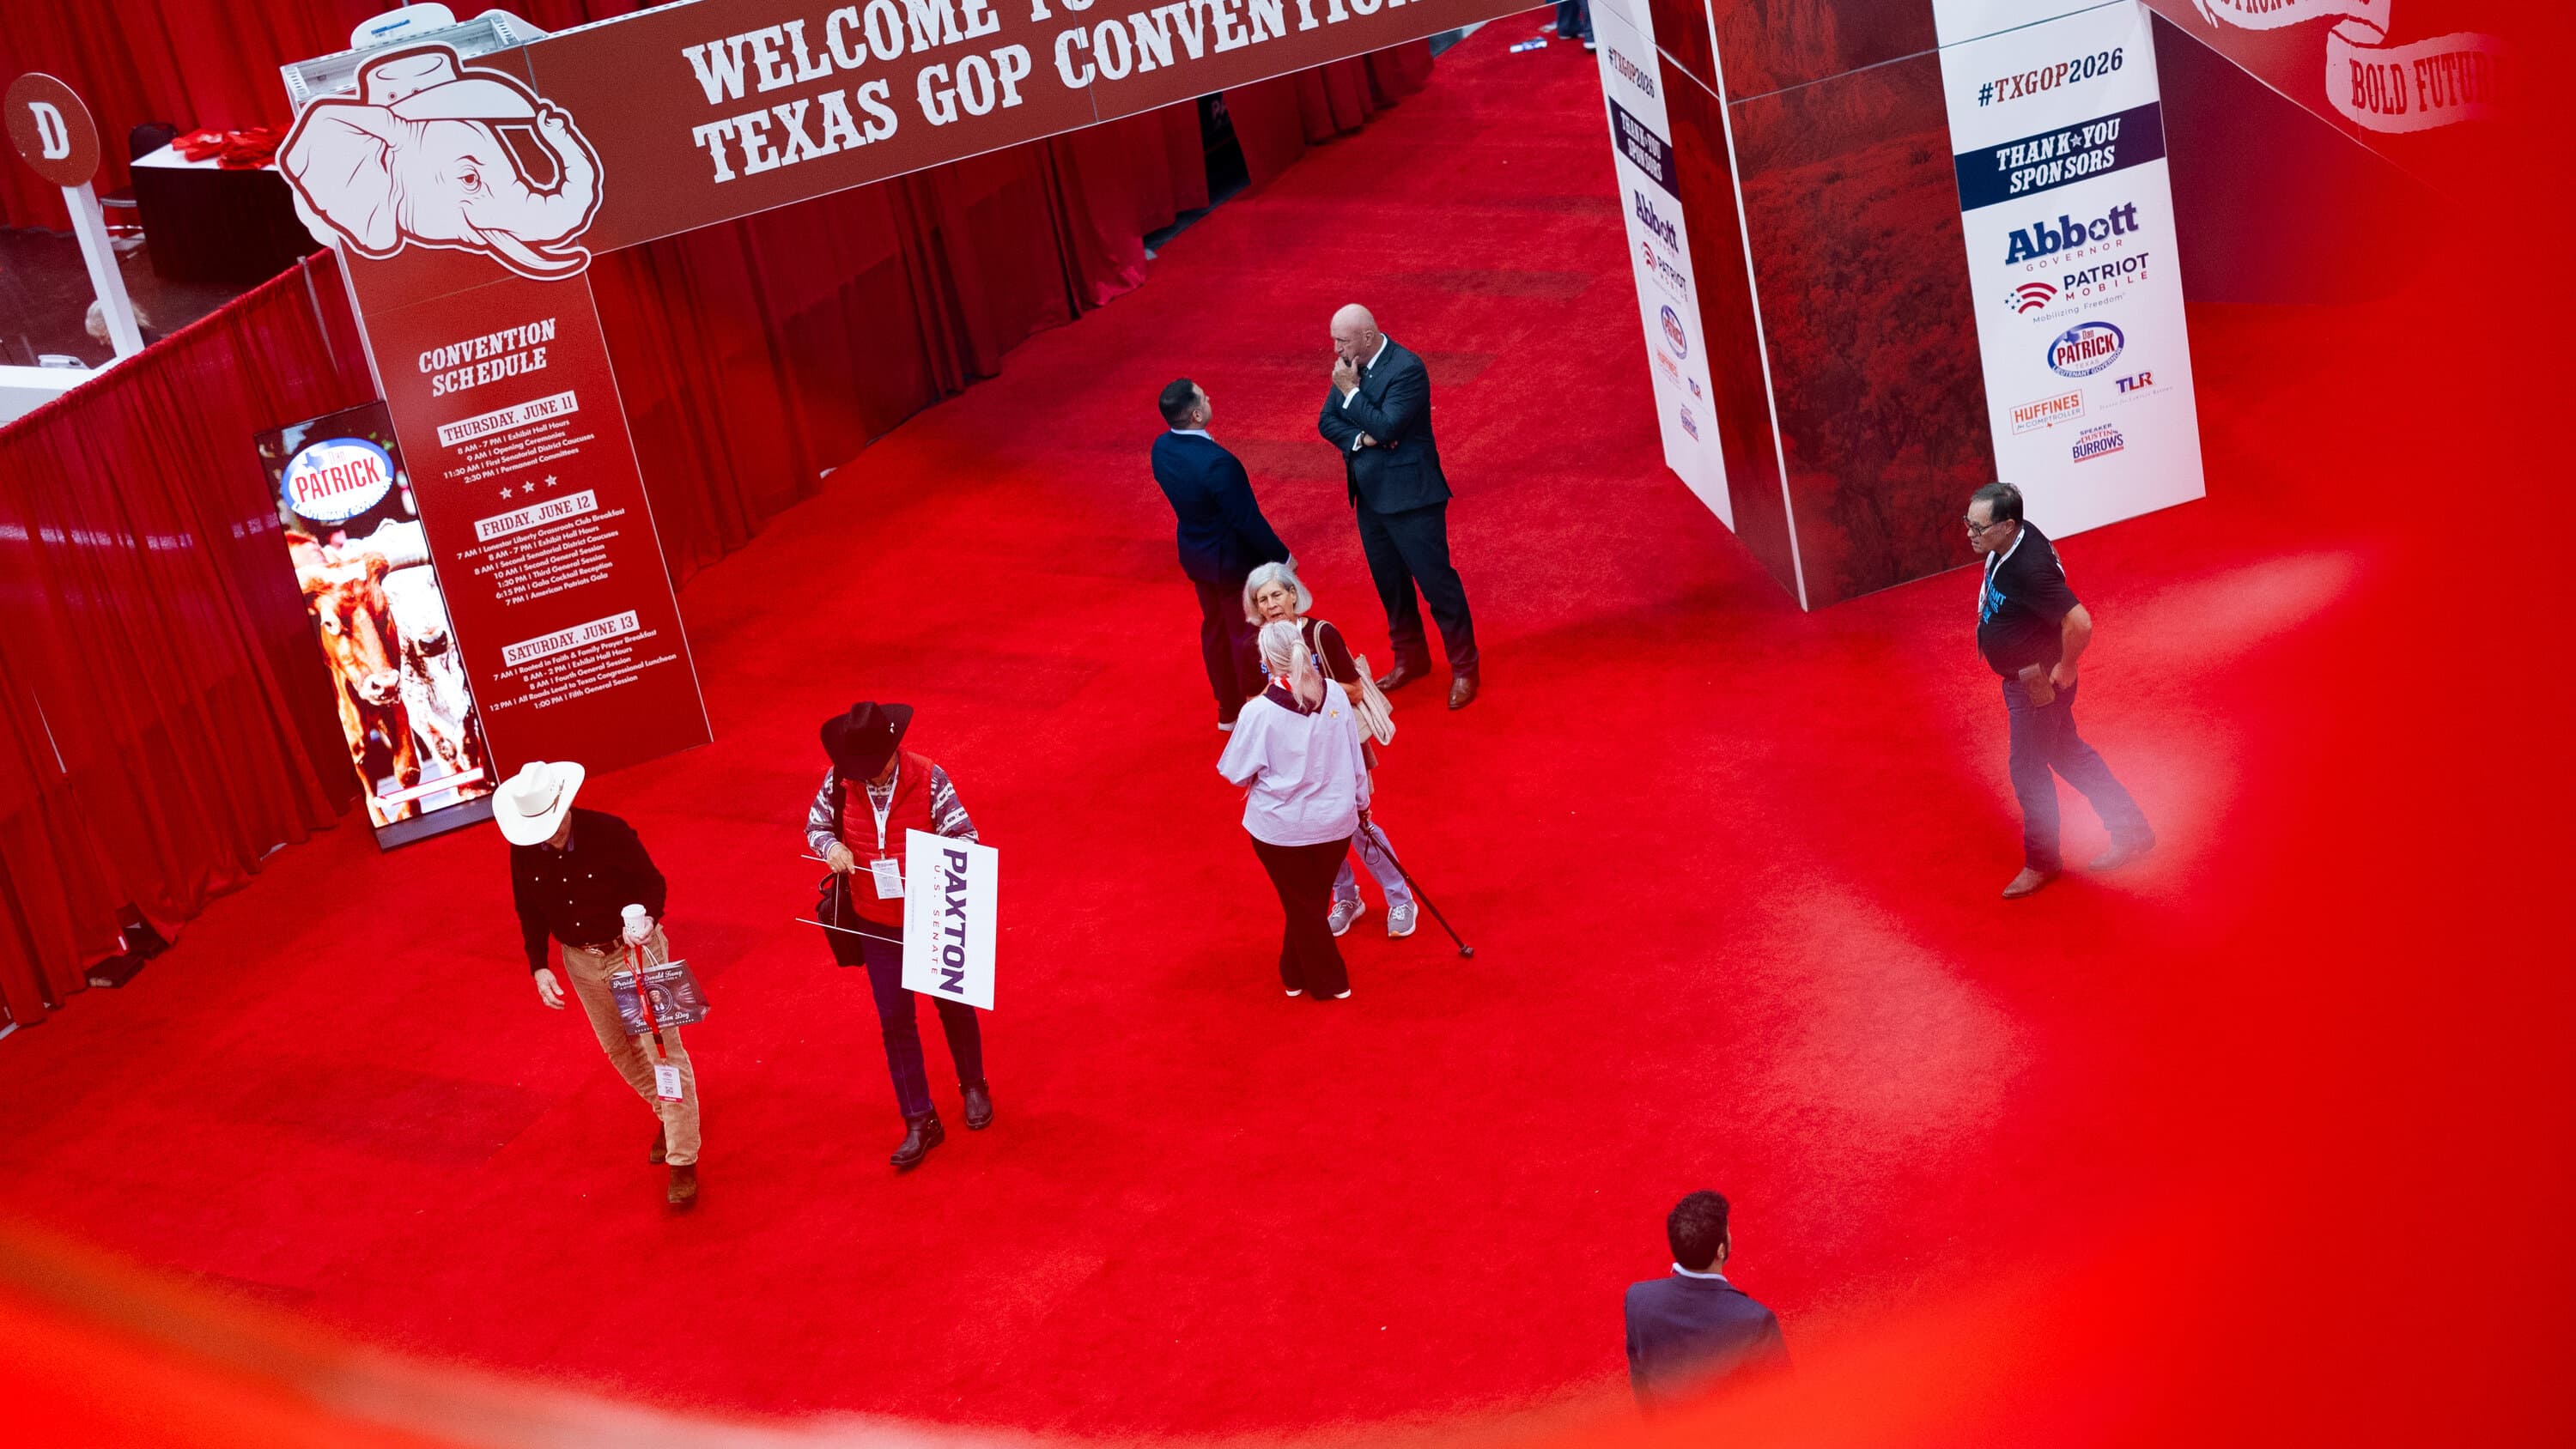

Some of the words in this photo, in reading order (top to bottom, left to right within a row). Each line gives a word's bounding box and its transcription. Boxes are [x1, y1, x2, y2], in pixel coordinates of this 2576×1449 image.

[682, 0, 1000, 105] WELCOME
[1608, 45, 1655, 99] #TXGOP2026
[1978, 47, 2123, 107] #TXGOP2026
[2349, 58, 2408, 115] BOLD
[28, 101, 70, 161] D
[692, 79, 898, 184] TEXAS
[917, 44, 1032, 126] GOP
[1627, 138, 1663, 182] SPONSORS
[1996, 131, 2073, 171] THANK
[2081, 118, 2121, 149] YOU
[2009, 145, 2115, 194] SPONSORS
[1634, 189, 1680, 254] Abbott
[2005, 201, 2139, 265] Abbott
[2026, 239, 2123, 272] GOVERNOR
[2063, 252, 2149, 290] PATRIOT
[2065, 271, 2148, 302] MOBILE
[2032, 306, 2080, 324] Mobilizing
[2082, 330, 2094, 340] Dan
[418, 318, 556, 373] CONVENTION
[2057, 333, 2116, 367] PATRICK
[432, 346, 547, 397] SCHEDULE
[2115, 372, 2154, 394] TLR
[443, 411, 519, 441] THURSDAY,
[523, 399, 557, 420] JUNE
[562, 396, 573, 409] 11
[2014, 394, 2080, 423] HUFFINES
[2026, 408, 2081, 428] COMPTROLLER
[2080, 422, 2112, 436] SPEAKER
[443, 467, 465, 479] 11:30
[466, 463, 480, 473] AM
[485, 458, 501, 467] First
[501, 446, 538, 463] Senatorial
[537, 441, 562, 453] District
[562, 433, 594, 446] Caucuses
[465, 443, 478, 453] AM
[489, 436, 502, 446] PM
[507, 429, 532, 440] Exhibit
[532, 423, 548, 433] Hall
[548, 420, 570, 429] Hours
[474, 451, 488, 460] AM
[493, 442, 525, 455] Opening
[524, 431, 566, 446] Ceremonies
[2072, 433, 2123, 459] BURROWS
[2081, 430, 2113, 445] DUSTIN
[295, 457, 380, 503] PATRICK
[464, 473, 482, 483] 2:30
[482, 469, 495, 478] PM
[500, 458, 538, 473] Permanent
[538, 447, 579, 463] Committees
[464, 549, 477, 558] AM
[483, 540, 512, 553] Lonestar
[513, 532, 537, 544] Liberty
[537, 522, 574, 537] Grassroots
[574, 516, 592, 526] Club
[592, 507, 625, 522] Breakfast
[482, 512, 534, 536] FRIDAY,
[538, 500, 573, 520] JUNE
[576, 495, 590, 509] 12
[481, 564, 495, 573] AM
[500, 554, 526, 567] Second
[526, 543, 562, 561] Senatorial
[562, 538, 586, 550] District
[586, 530, 618, 543] Caucuses
[494, 571, 504, 579] 10
[505, 567, 519, 577] AM
[523, 557, 550, 571] Second
[550, 549, 579, 563] General
[579, 544, 605, 555] Session
[495, 549, 508, 559] AM
[519, 543, 532, 552] PM
[538, 535, 562, 547] Exhibit
[562, 530, 578, 540] Hall
[578, 525, 599, 536] Hours
[495, 588, 513, 599] 6:15
[513, 585, 526, 593] PM
[532, 579, 550, 588] Gala
[550, 569, 579, 583] Cocktail
[578, 561, 613, 575] Reception
[497, 578, 514, 588] 1:30
[514, 574, 527, 584] PM
[532, 567, 551, 578] Third
[551, 559, 580, 573] General
[580, 554, 606, 565] Session
[512, 595, 525, 604] PM
[531, 585, 563, 599] American
[563, 578, 590, 589] Patriots
[590, 572, 608, 582] Gala
[500, 670, 513, 679] AM
[519, 660, 544, 674] Rooted
[551, 653, 569, 664] Faith
[577, 645, 600, 657] Family
[600, 639, 623, 650] Prayer
[623, 629, 657, 643] Breakfast
[507, 631, 579, 662] SATURDAY,
[583, 620, 617, 640] JUNE
[620, 615, 634, 629] 13
[489, 703, 500, 712] 12
[500, 700, 513, 708] PM
[518, 694, 528, 703] All
[528, 688, 550, 700] Roads
[550, 682, 568, 694] Lead
[576, 676, 597, 686] Texas
[597, 661, 644, 680] Congressional
[644, 653, 677, 667] Luncheon
[530, 671, 544, 680] AM
[554, 664, 567, 673] PM
[572, 656, 595, 668] Exhibit
[596, 651, 611, 661] Hall
[611, 646, 633, 657] Hours
[536, 679, 550, 688] AM
[555, 671, 577, 682] Fourth
[576, 662, 605, 676] General
[605, 657, 631, 668] Session
[533, 699, 550, 709] 1:00
[550, 695, 563, 704] PM
[568, 689, 584, 699] Fifth
[584, 681, 612, 694] General
[612, 675, 638, 686] Session
[939, 847, 968, 995] PAXTON
[931, 910, 940, 975] SENATE
